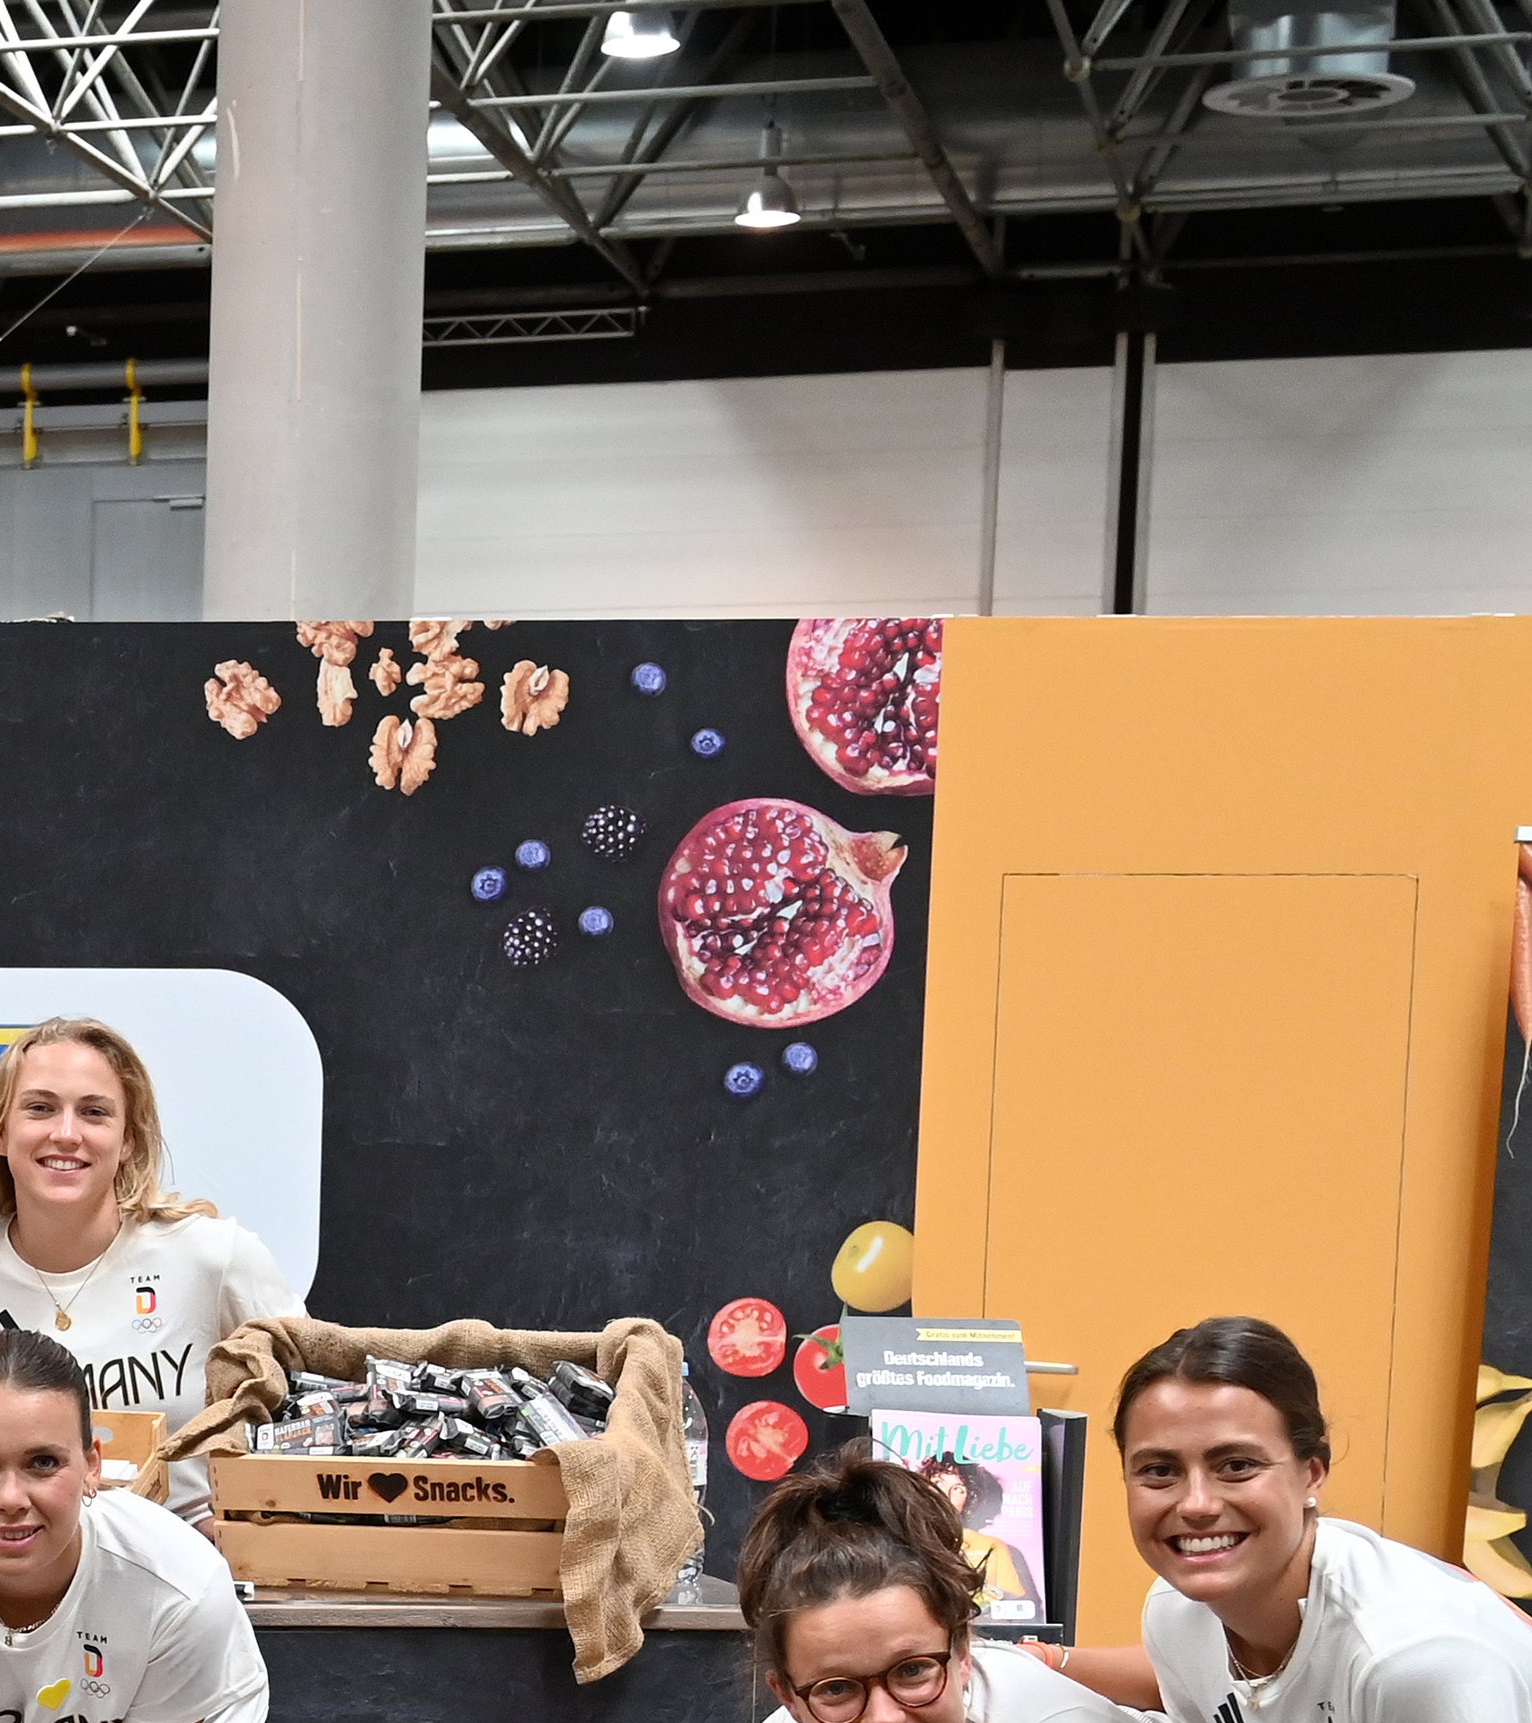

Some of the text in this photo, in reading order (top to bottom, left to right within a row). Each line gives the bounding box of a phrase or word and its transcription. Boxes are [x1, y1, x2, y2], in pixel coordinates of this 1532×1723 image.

[129, 1274, 161, 1284] TEAM
[883, 1350, 984, 1367] Deutschlands
[856, 1370, 1016, 1389] größtes Foodmagazin.
[881, 1421, 1033, 1465] Mit Liebe
[317, 1473, 516, 1504] Wir Snacks.
[1011, 1481, 1033, 1493] AUF
[1002, 1494, 1033, 1505] NACH
[1001, 1506, 1034, 1519] PARIS
[77, 1631, 108, 1645] TEAM
